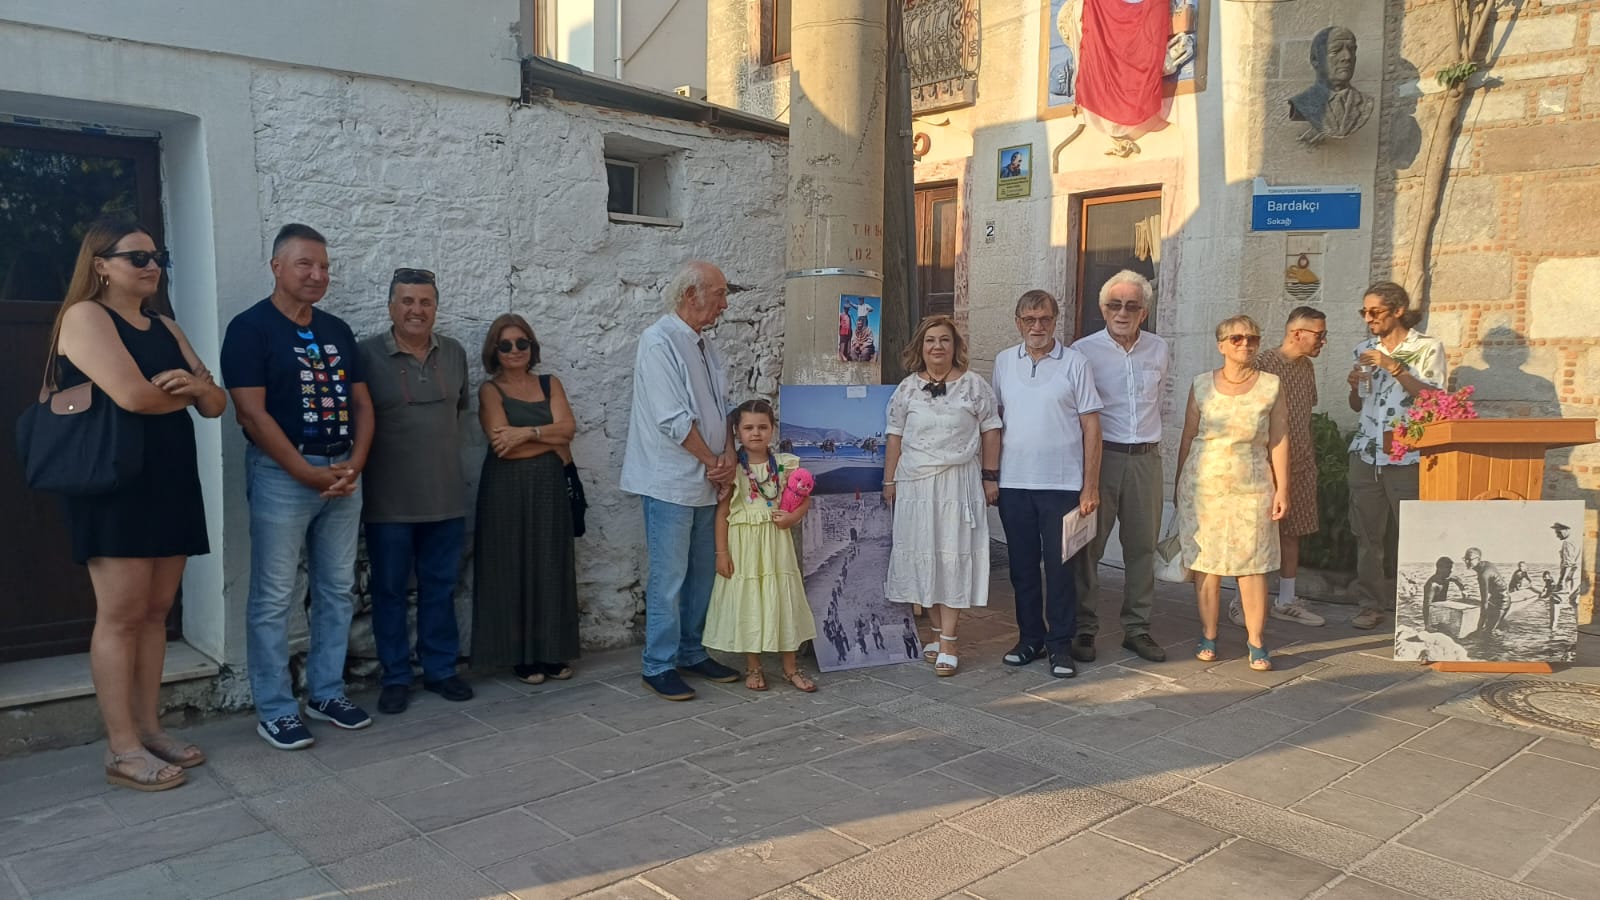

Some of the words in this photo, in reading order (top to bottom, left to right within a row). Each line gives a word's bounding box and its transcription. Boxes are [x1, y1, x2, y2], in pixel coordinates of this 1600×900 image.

[1267, 200, 1320, 213] Bardakçı
[1266, 217, 1292, 226] Sokağı
[986, 225, 994, 237] 2
